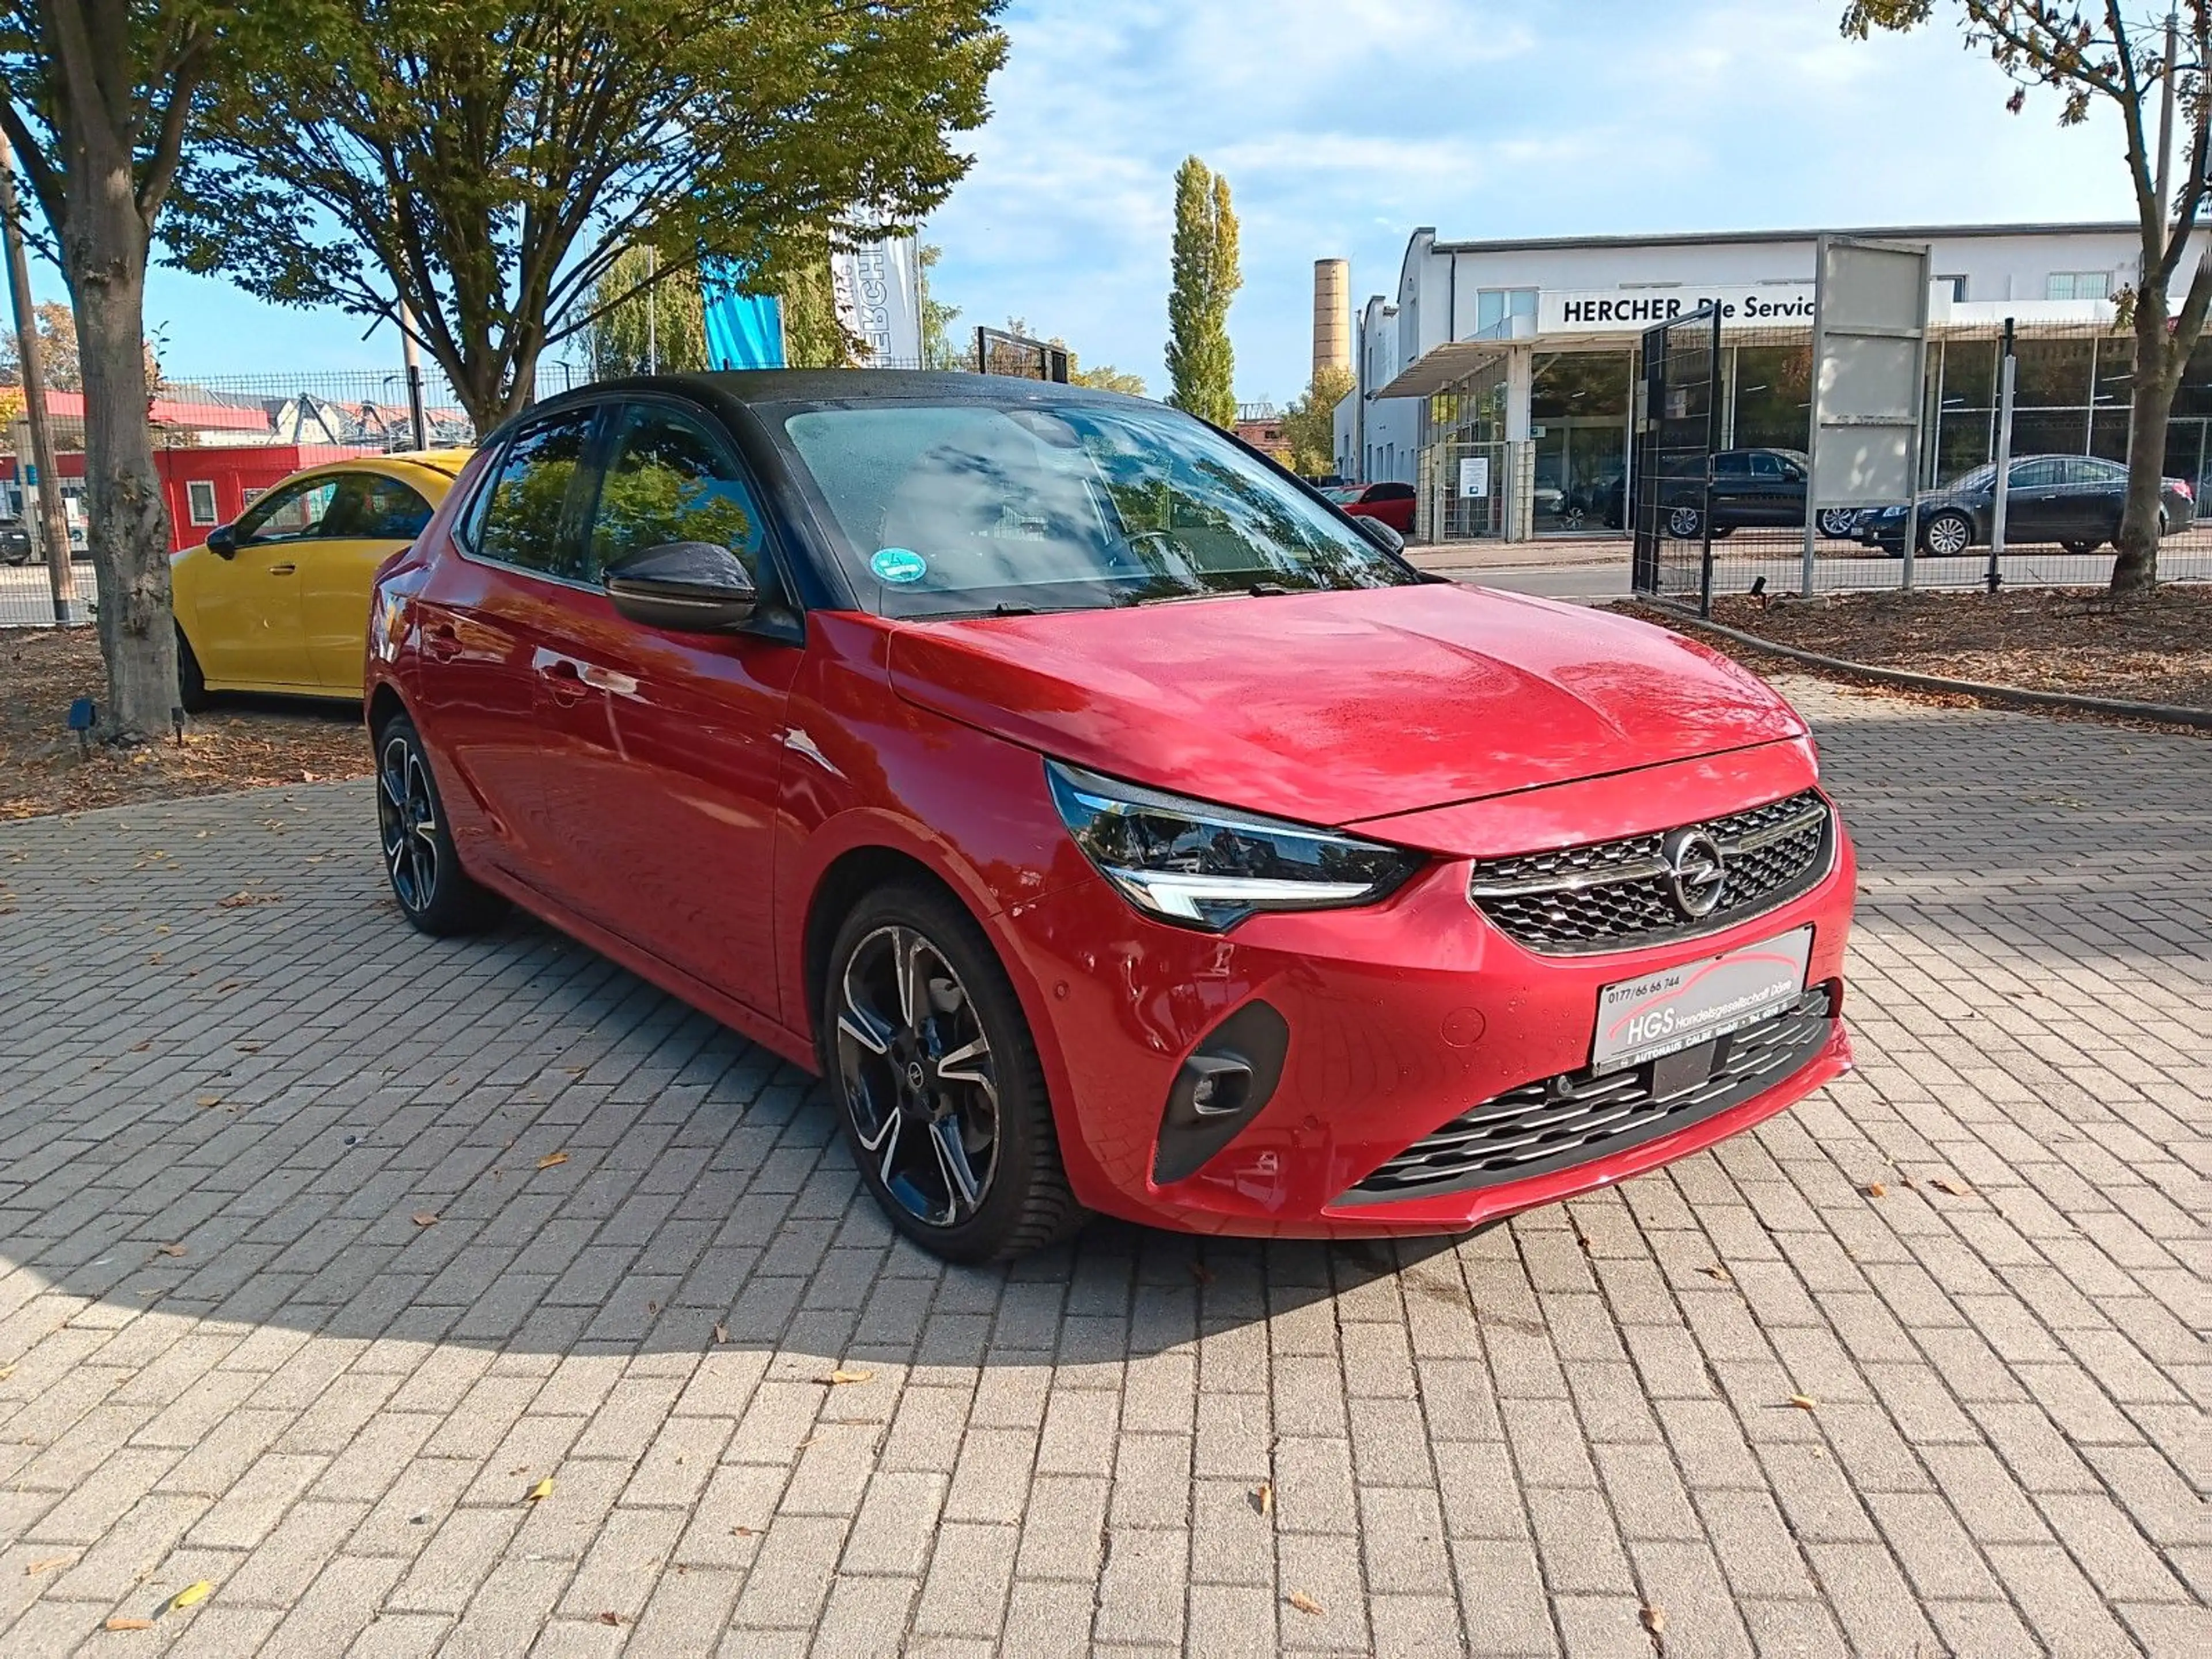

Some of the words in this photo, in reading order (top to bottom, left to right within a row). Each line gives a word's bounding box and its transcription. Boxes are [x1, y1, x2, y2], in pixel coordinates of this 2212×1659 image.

[1564, 298, 1681, 322] HERCHER
[1664, 976, 1680, 989] 744
[1627, 1007, 1675, 1045] HGS
[1633, 1041, 1683, 1064] AUTOHAUS
